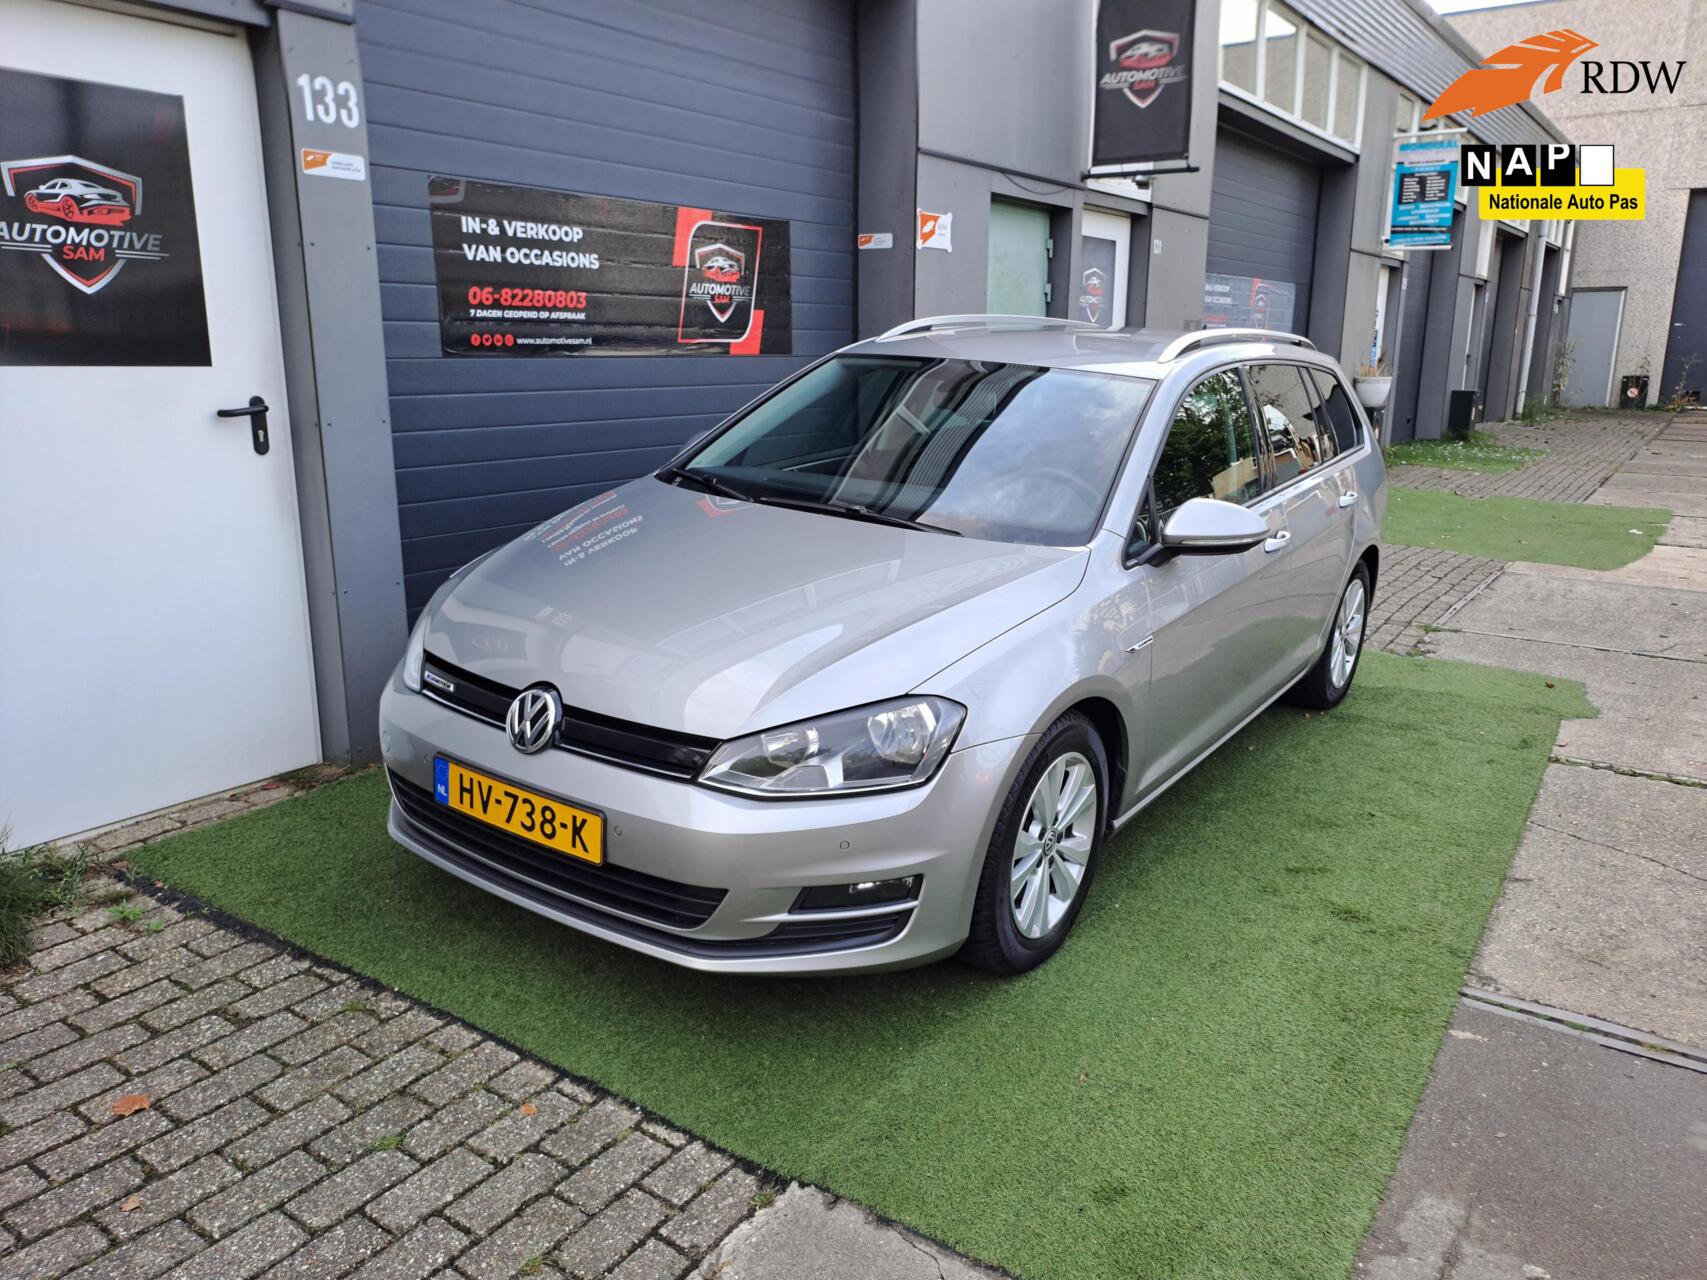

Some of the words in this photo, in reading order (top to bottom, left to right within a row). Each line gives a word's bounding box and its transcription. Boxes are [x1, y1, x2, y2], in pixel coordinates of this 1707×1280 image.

[1100, 64, 1186, 85] AUTOMOTIVE
[297, 73, 360, 128] 133
[503, 220, 584, 243] VERKOOP
[62, 245, 105, 261] SAM
[462, 243, 502, 262] VAN
[505, 247, 600, 269] OCCASIONS
[468, 286, 588, 308] 06-82280803
[688, 283, 751, 296] AUTOMOTIVE
[469, 309, 476, 318] 7
[476, 309, 502, 319] DAGEN
[503, 310, 539, 319] GEOPEND
[539, 311, 550, 320] OP
[550, 312, 586, 320] AFSPRAAK
[516, 336, 593, 345] www.automotivesam.nl
[437, 783, 448, 797] NL
[459, 772, 590, 854] HV-738-K
